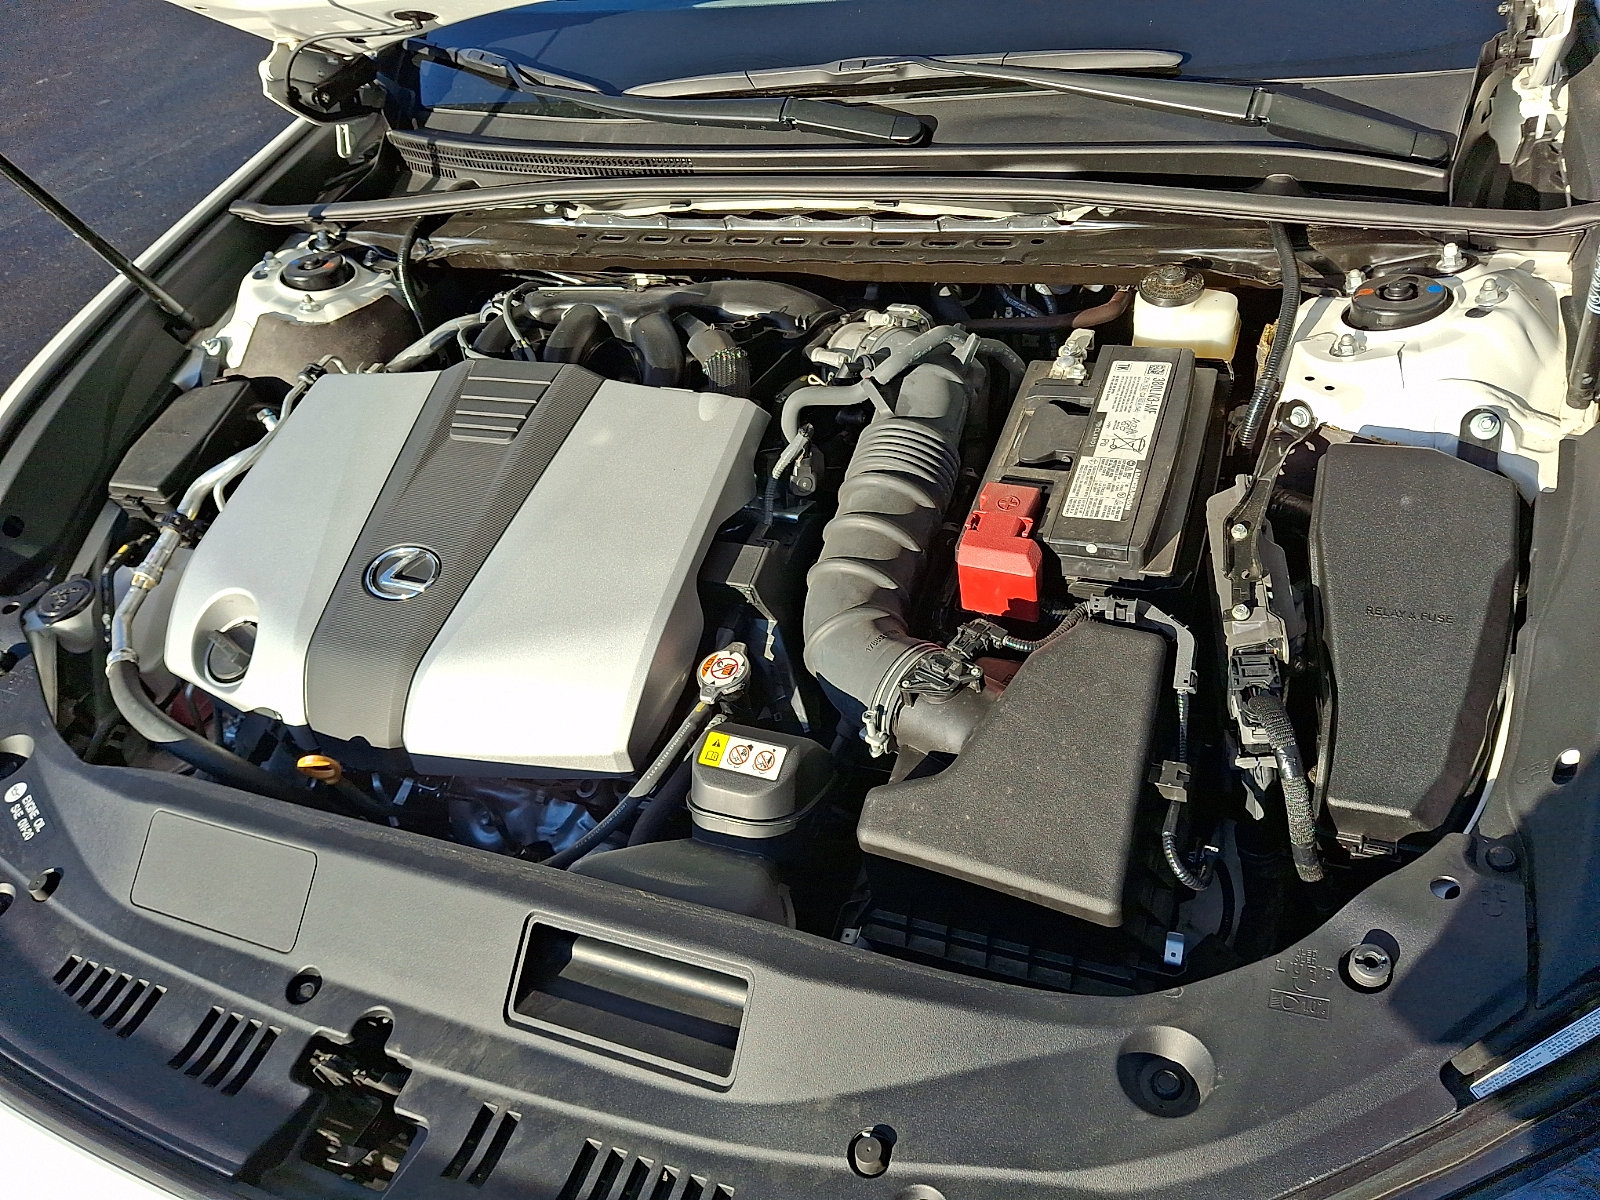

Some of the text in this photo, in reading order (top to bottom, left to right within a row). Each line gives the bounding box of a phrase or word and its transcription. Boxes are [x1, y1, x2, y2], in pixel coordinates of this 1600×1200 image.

[1366, 605, 1406, 619] RELAY
[1420, 612, 1455, 625] FUSE
[10, 803, 34, 841] SAE 0W-20
[22, 794, 46, 833] ENGINE OIL
